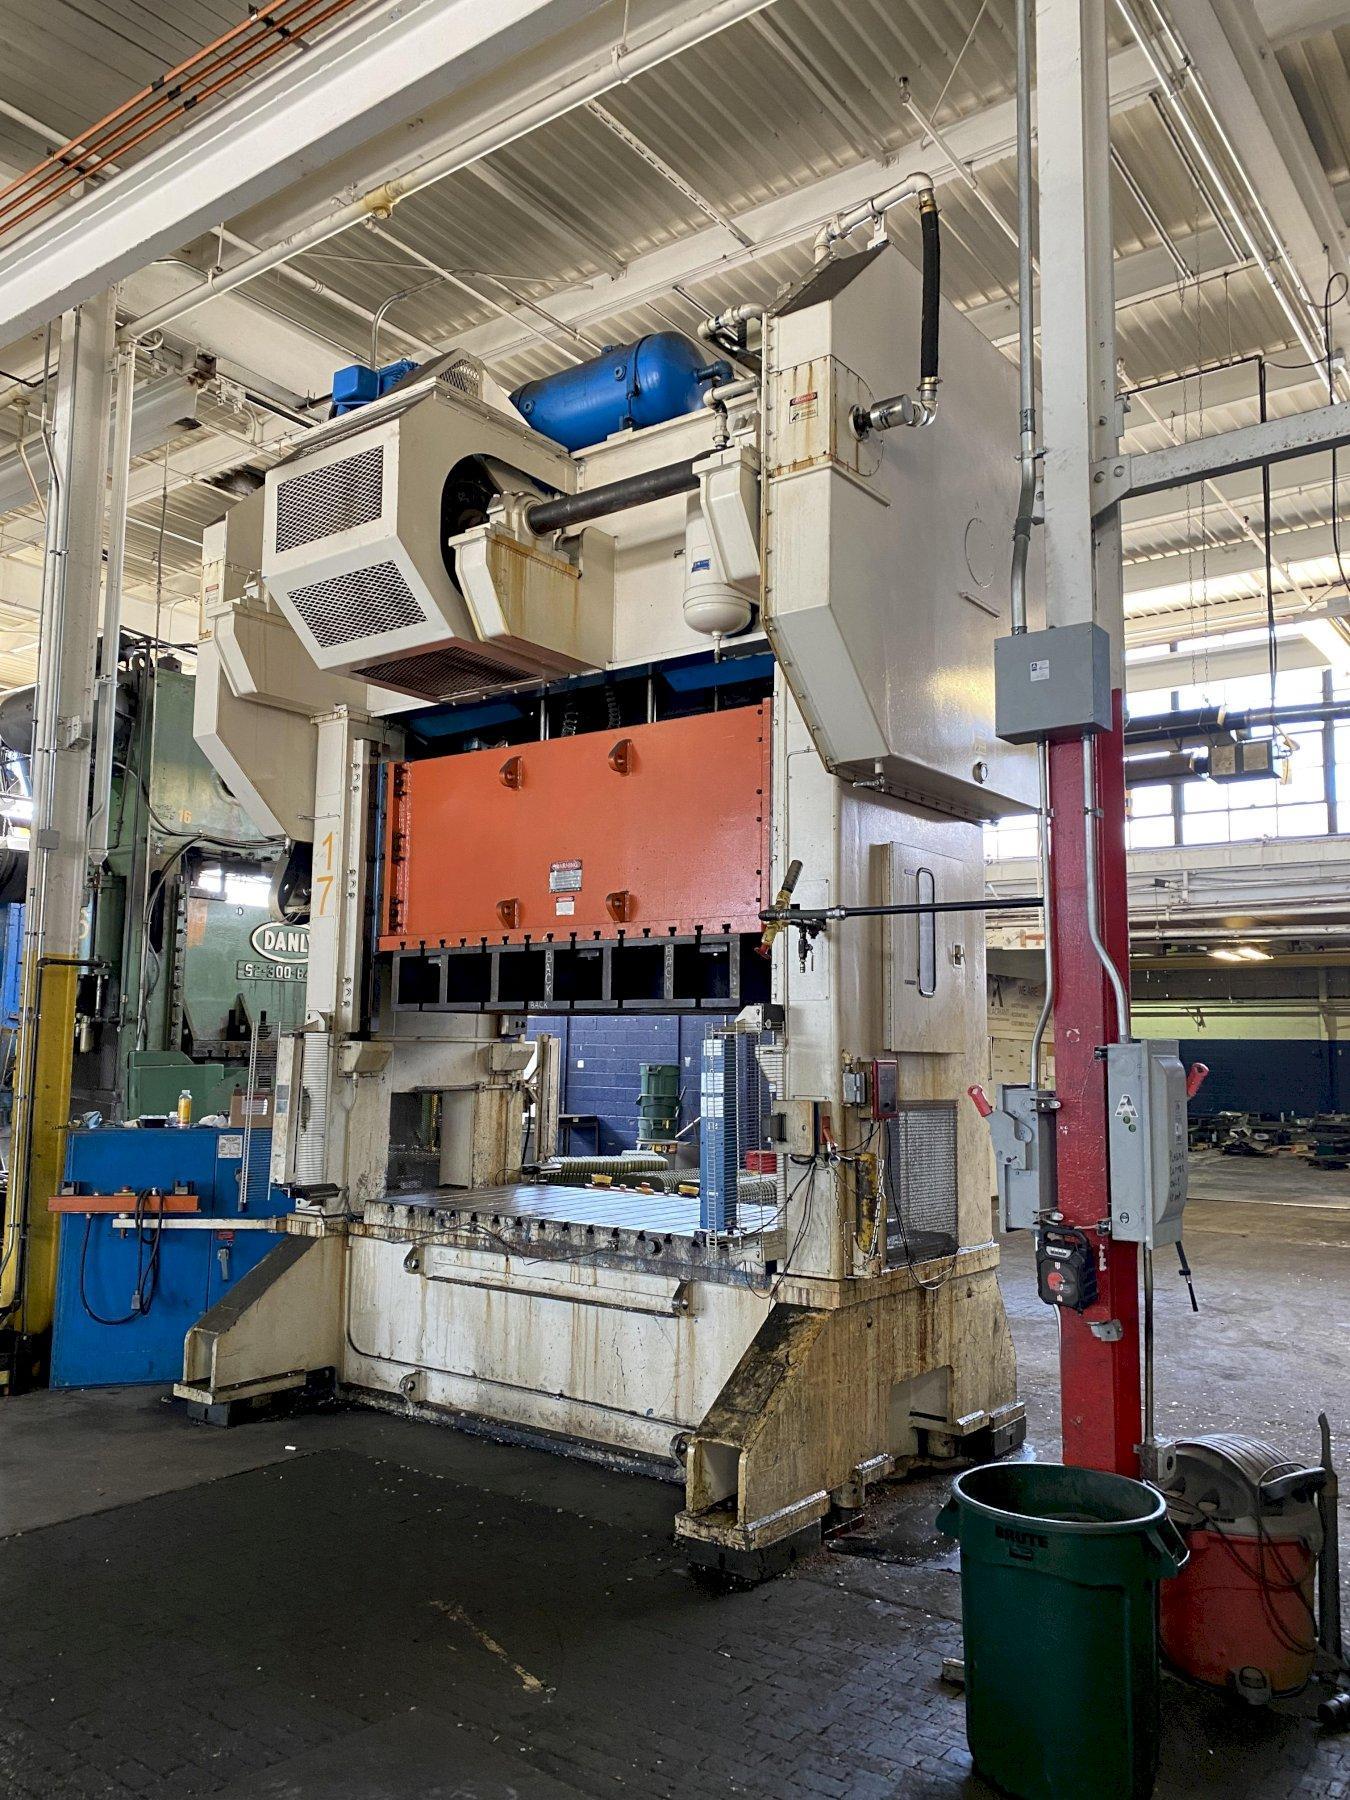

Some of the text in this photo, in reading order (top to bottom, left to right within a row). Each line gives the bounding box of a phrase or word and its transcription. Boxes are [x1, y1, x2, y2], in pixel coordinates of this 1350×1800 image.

[545, 951, 553, 996] BACK
[530, 1001, 548, 1009] BACK
[995, 1524, 1049, 1548] BRUTE
